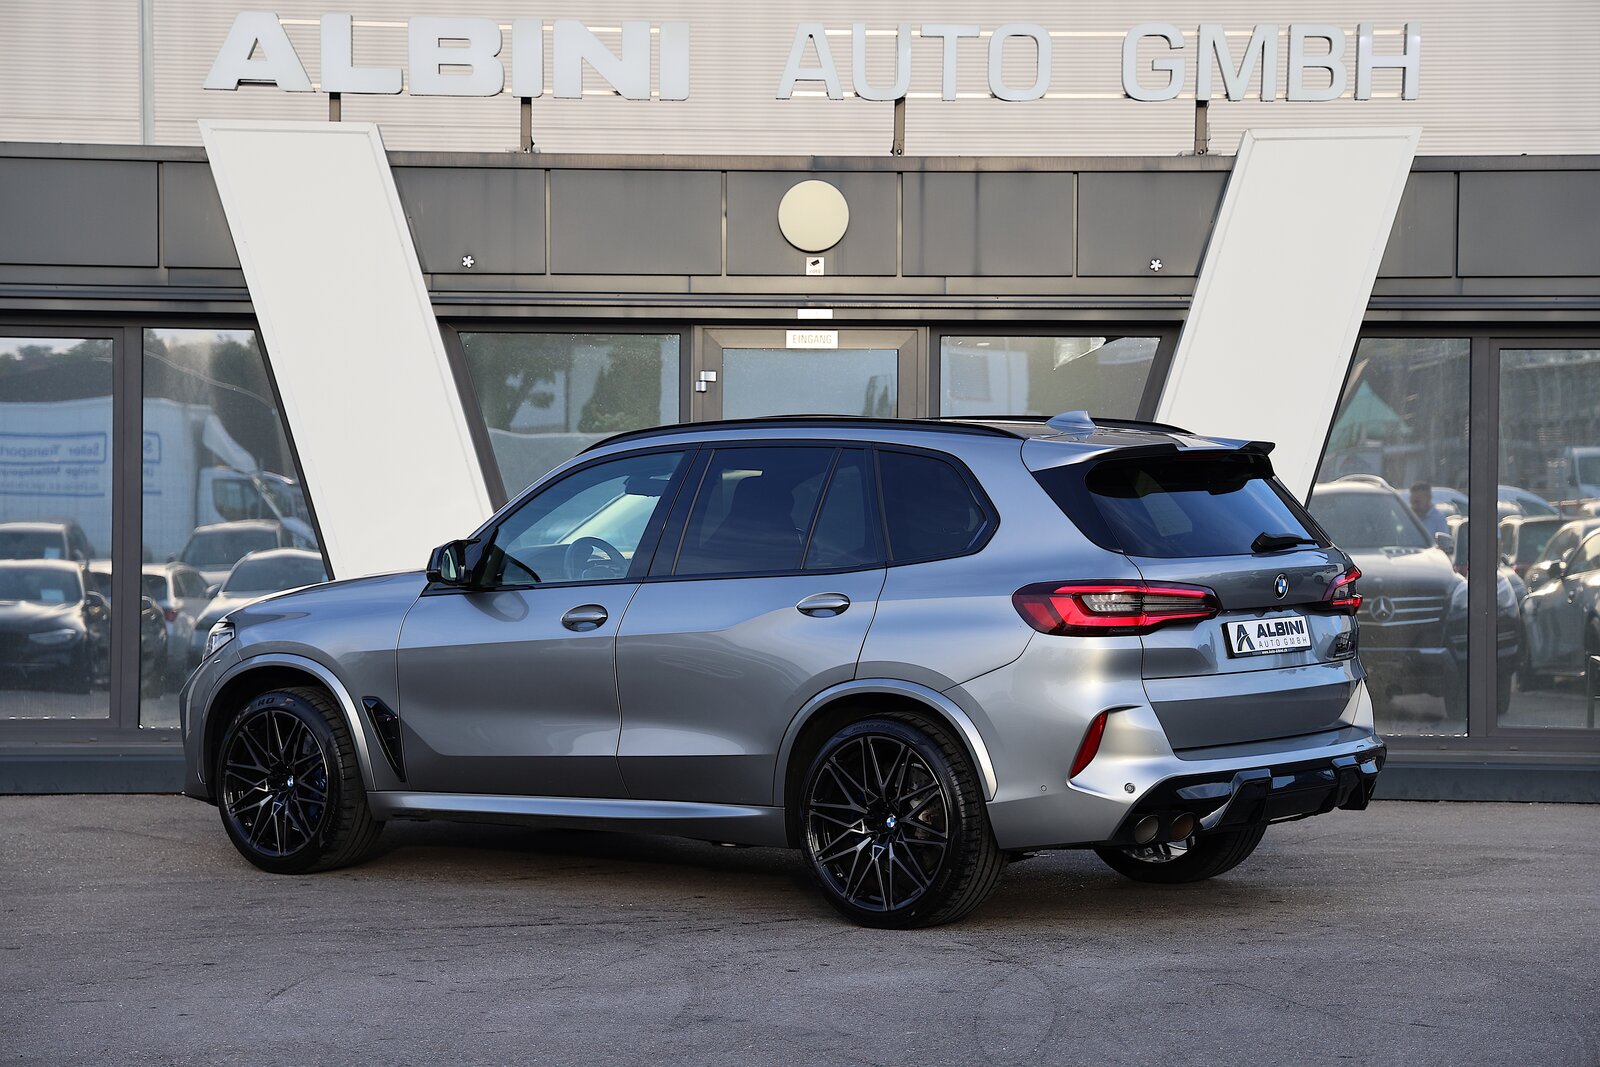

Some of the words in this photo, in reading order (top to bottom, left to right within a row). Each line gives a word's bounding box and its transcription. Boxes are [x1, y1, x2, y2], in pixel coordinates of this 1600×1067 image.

[203, 11, 691, 101] ALBINI
[776, 23, 1052, 102] AUTO
[1122, 23, 1422, 102] GMBH
[792, 334, 832, 345] EINGANG
[1257, 620, 1305, 638] ALBINI
[1258, 638, 1281, 649] AUTO
[1283, 636, 1308, 646] GMBH
